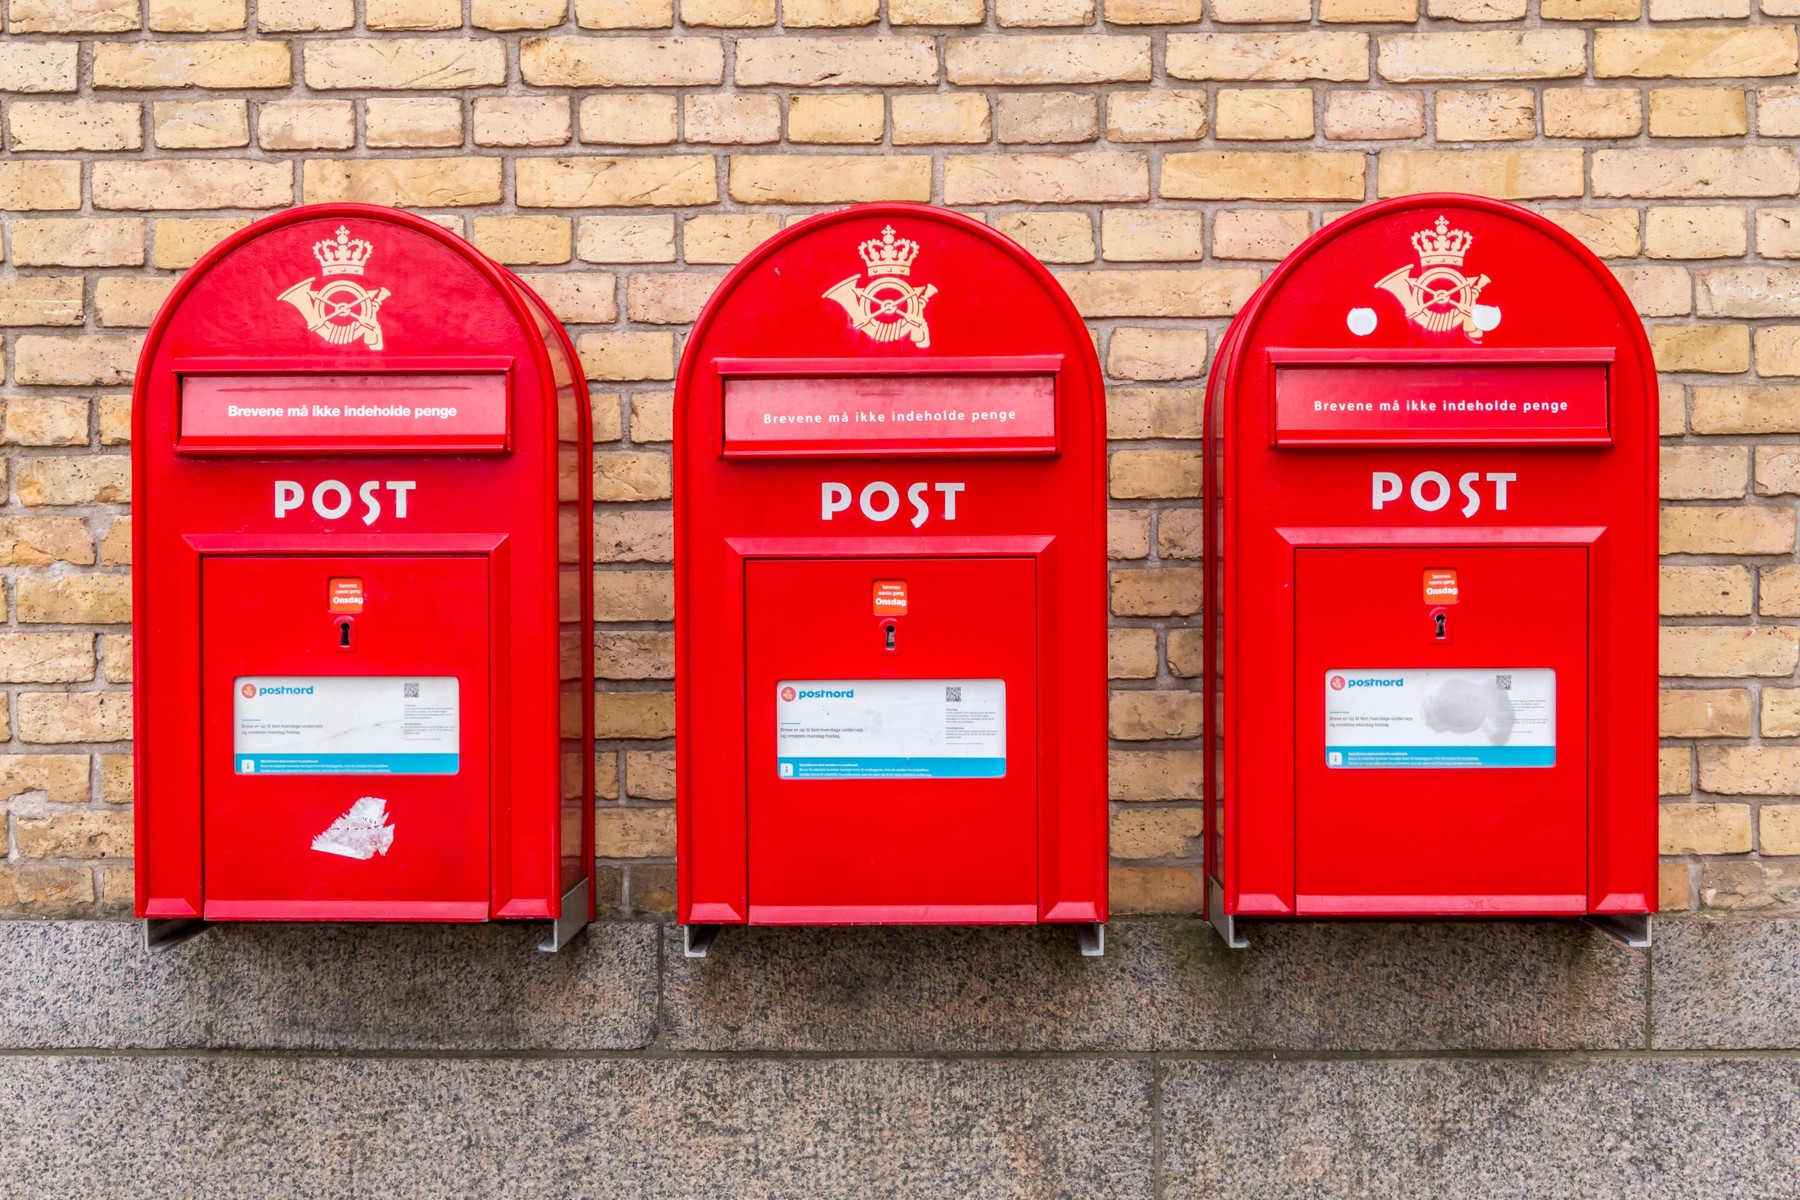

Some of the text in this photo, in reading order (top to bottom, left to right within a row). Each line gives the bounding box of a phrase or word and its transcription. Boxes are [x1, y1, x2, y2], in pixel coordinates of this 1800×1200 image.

[227, 404, 457, 419] Brevene må ikke indeholde penge
[1314, 398, 1568, 413] Brevene må ikke indeholde penge
[763, 410, 1016, 424] Brevene må ikke indeholde penge
[1372, 471, 1517, 518] POST
[274, 480, 416, 525] POST
[821, 481, 965, 528] POST
[1426, 587, 1459, 596] Onsdag
[333, 596, 364, 605] Onsdag
[875, 597, 907, 607] Onsdag
[1347, 677, 1404, 689] postnord
[259, 685, 314, 697] postnord
[798, 689, 855, 700] postnord
